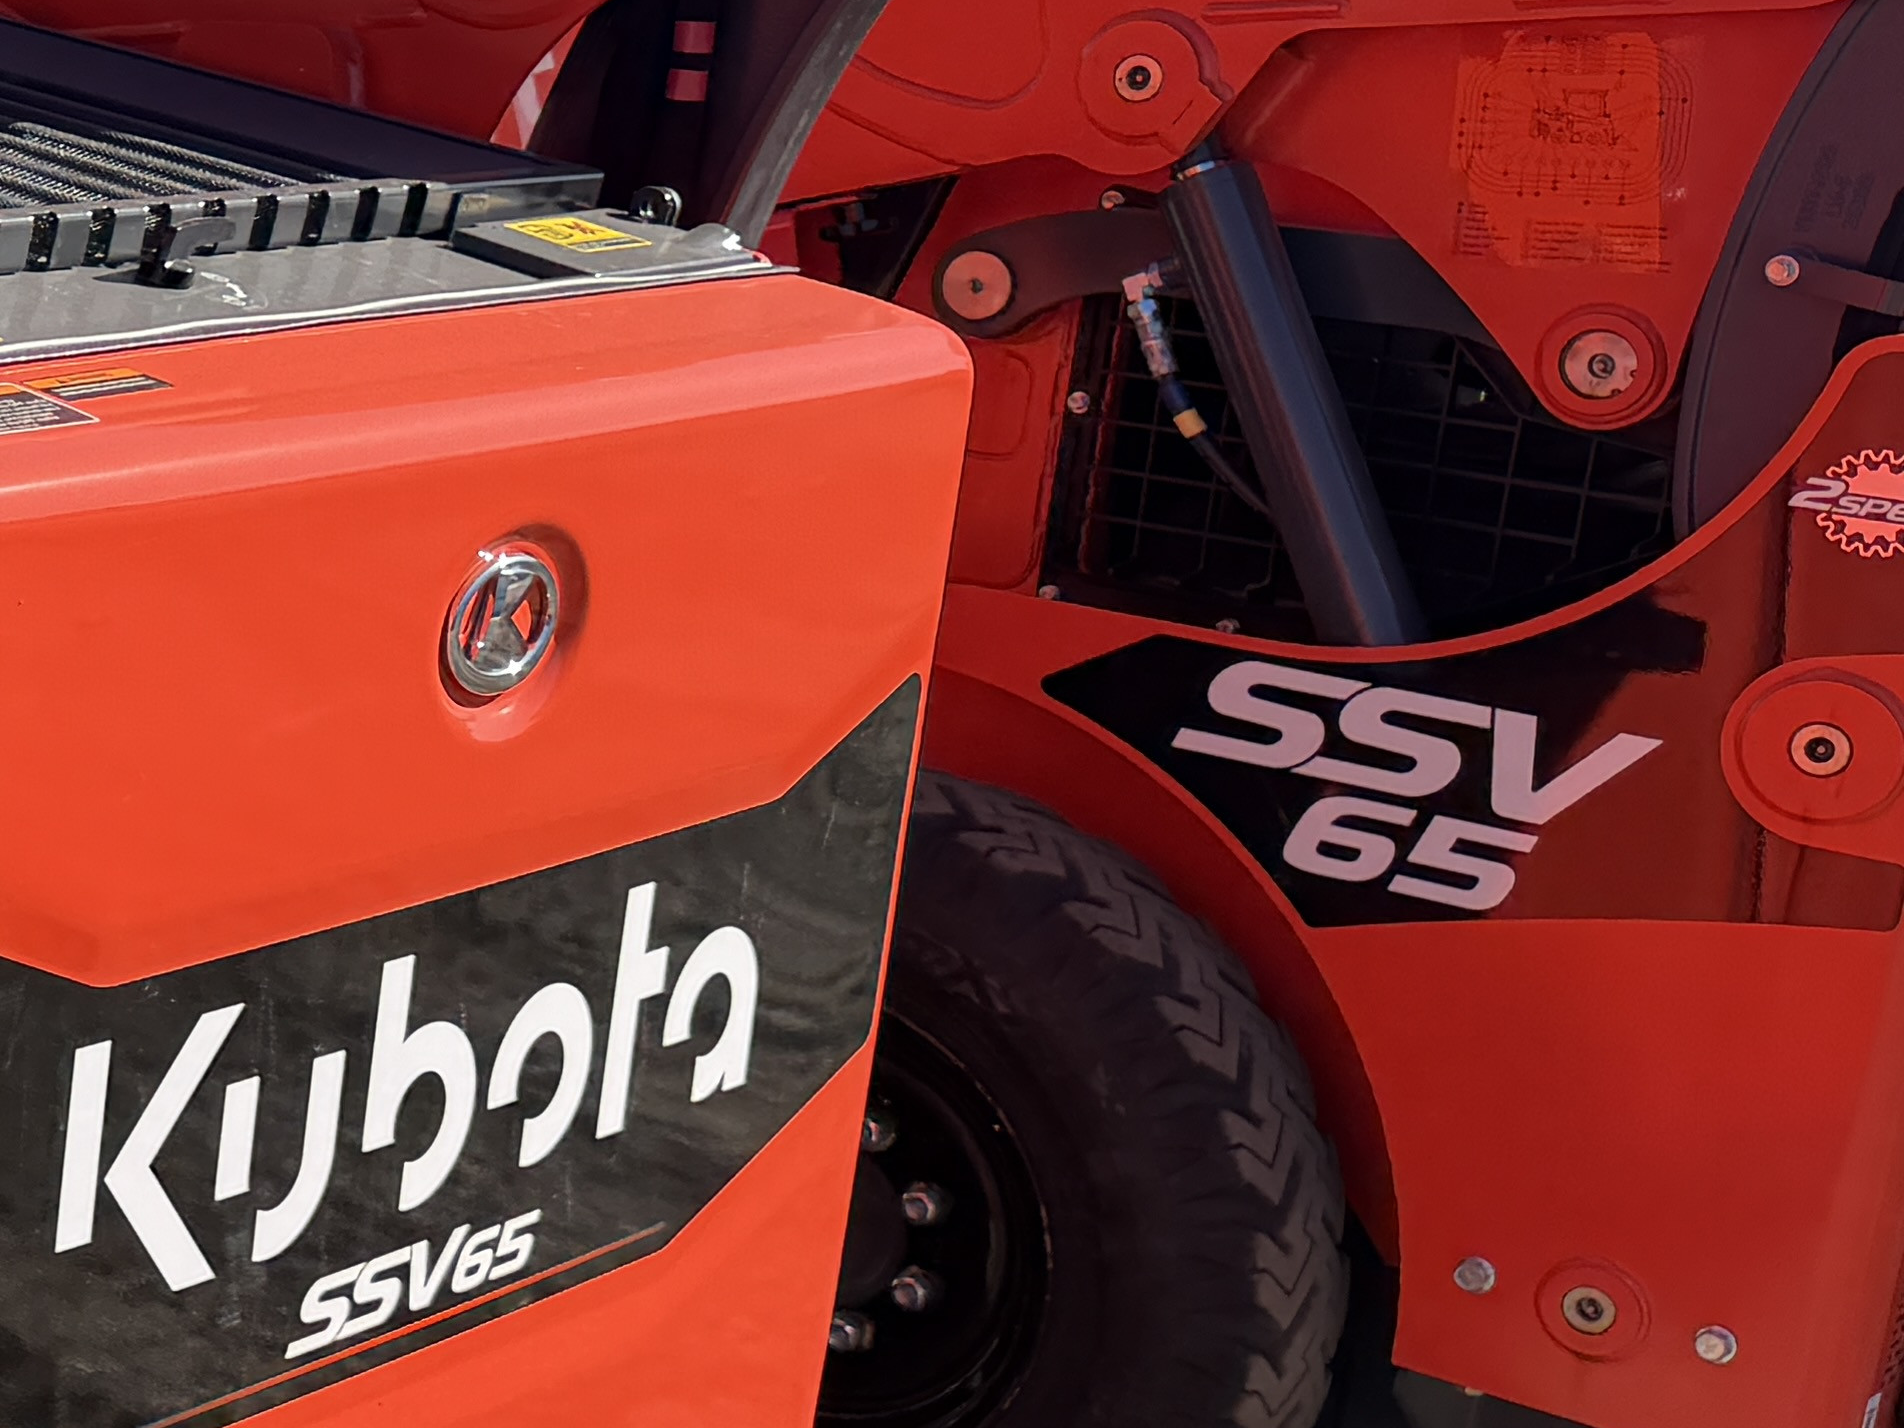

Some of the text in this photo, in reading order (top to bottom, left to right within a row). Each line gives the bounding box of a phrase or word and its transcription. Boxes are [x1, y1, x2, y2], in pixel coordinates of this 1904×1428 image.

[1171, 660, 1663, 825] SSV
[1282, 796, 1539, 911] 65
[55, 882, 759, 1293] Kubota
[284, 1209, 543, 1360] SSV65
